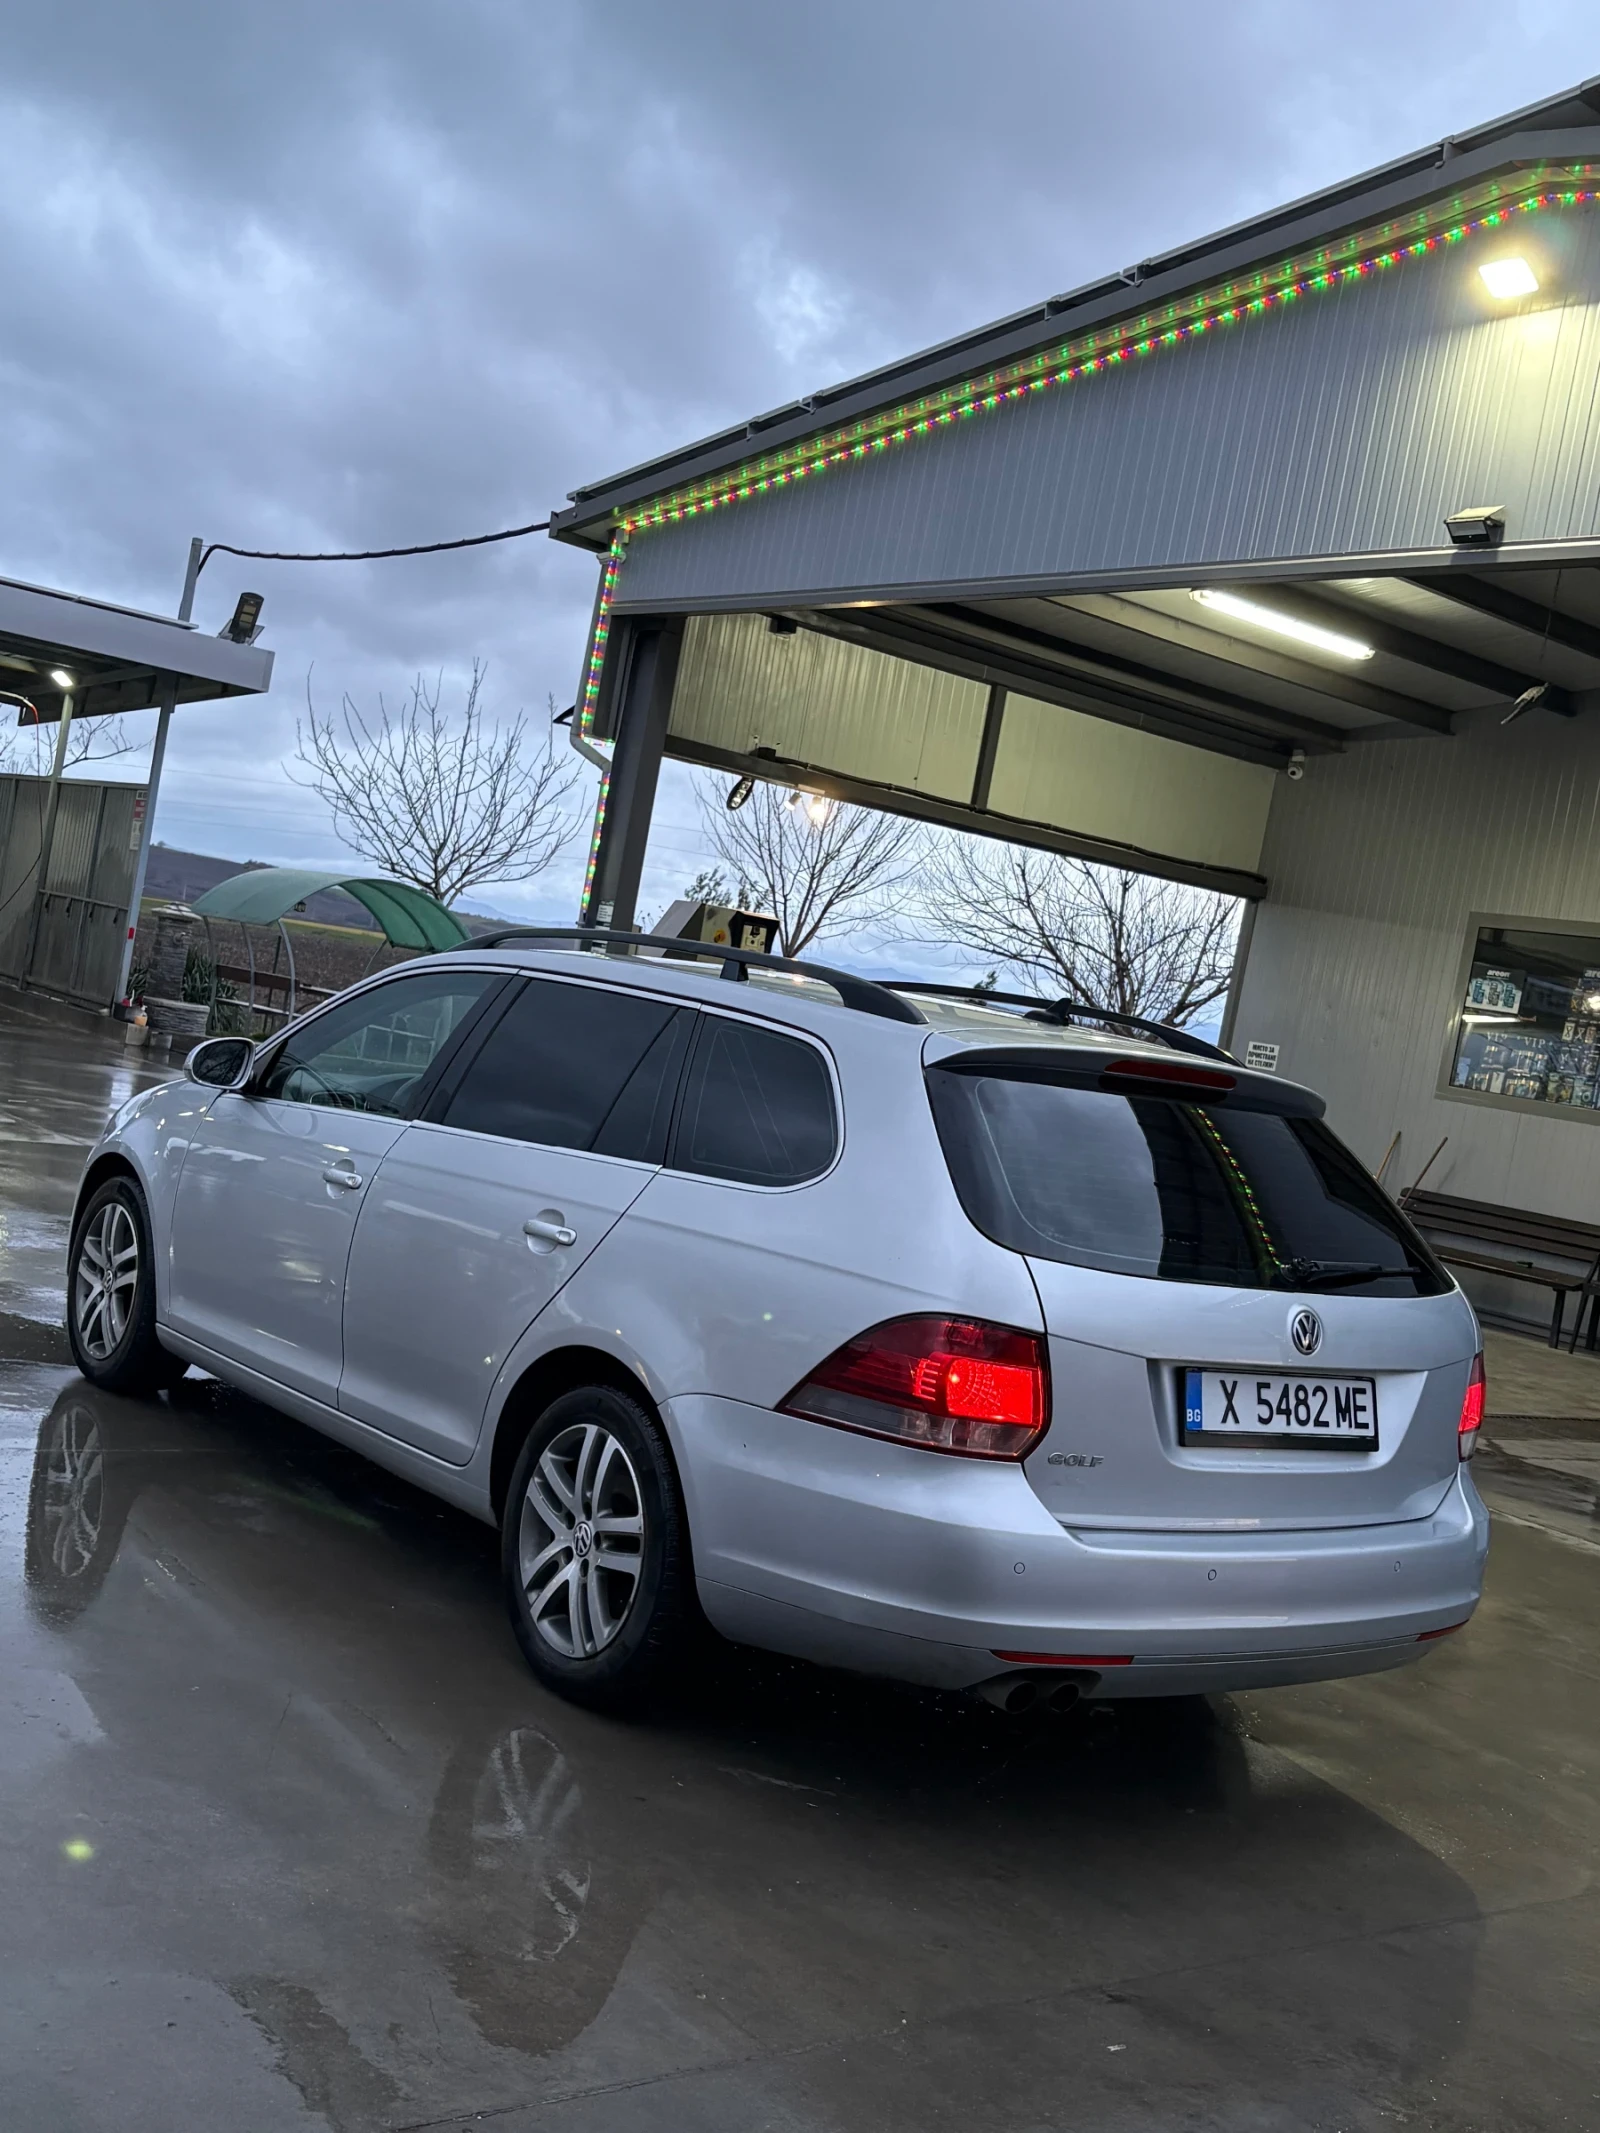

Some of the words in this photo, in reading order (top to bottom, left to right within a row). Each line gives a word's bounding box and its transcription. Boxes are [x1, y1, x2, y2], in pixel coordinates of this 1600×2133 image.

[1524, 1037, 1546, 1048] VIP
[1219, 1379, 1240, 1424] X
[1256, 1382, 1330, 1428] 5482
[1335, 1386, 1370, 1430] ME
[1186, 1408, 1201, 1422] BG
[1047, 1452, 1105, 1468] GOLF
